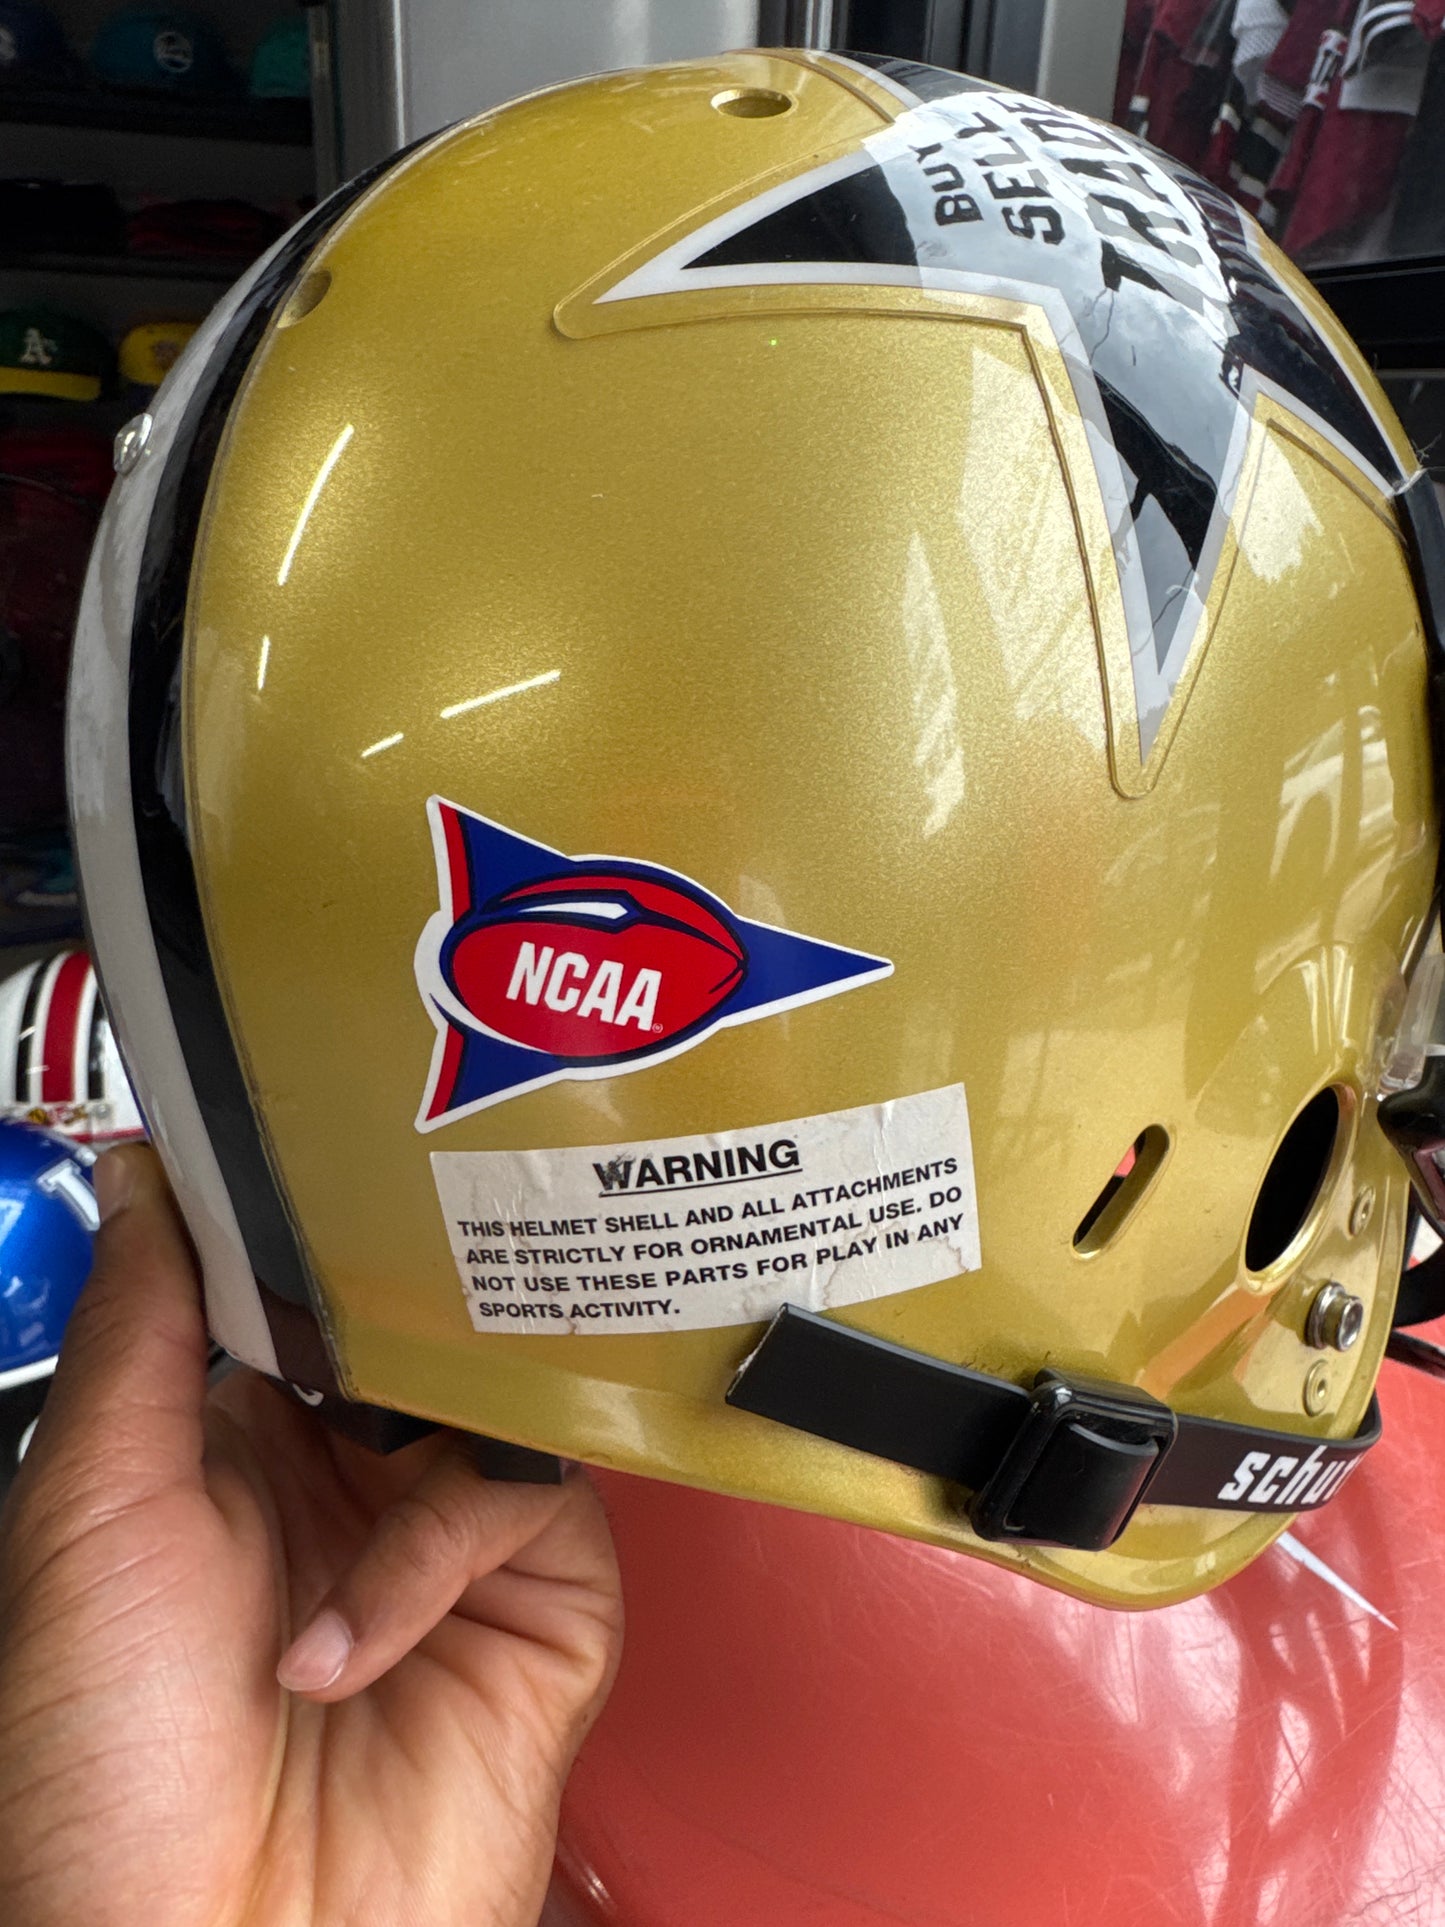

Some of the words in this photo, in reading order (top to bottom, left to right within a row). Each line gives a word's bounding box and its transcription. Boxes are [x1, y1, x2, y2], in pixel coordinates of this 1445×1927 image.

[908, 142, 985, 226] BUY
[955, 111, 1067, 245] SELL
[986, 95, 1240, 337] TRADE
[506, 942, 662, 1031] NCAA
[458, 1220, 504, 1238] THIS
[510, 1218, 598, 1237] HELMET
[605, 1212, 673, 1234] SHELL
[685, 1205, 733, 1226] AND
[741, 1198, 785, 1220] ALL
[791, 1157, 958, 1211] ATTACHMENTS
[593, 1139, 800, 1192] WARNING
[466, 1247, 509, 1265] ARE
[515, 1246, 625, 1265] STRICTLY
[634, 1241, 682, 1261] FOR
[691, 1214, 862, 1256] ORNAMENTAL
[869, 1200, 922, 1226] USE.
[929, 1186, 962, 1209] DO
[472, 1276, 516, 1292] NOT
[523, 1276, 571, 1293] USE
[576, 1274, 657, 1292] THESE
[666, 1262, 748, 1287] PARTS
[757, 1252, 808, 1276] FOR
[816, 1237, 876, 1267] PLAY
[886, 1231, 910, 1249] IN
[917, 1213, 964, 1243] ANY
[479, 1302, 564, 1319] SPORTS
[570, 1298, 681, 1319] ACTIVITY.
